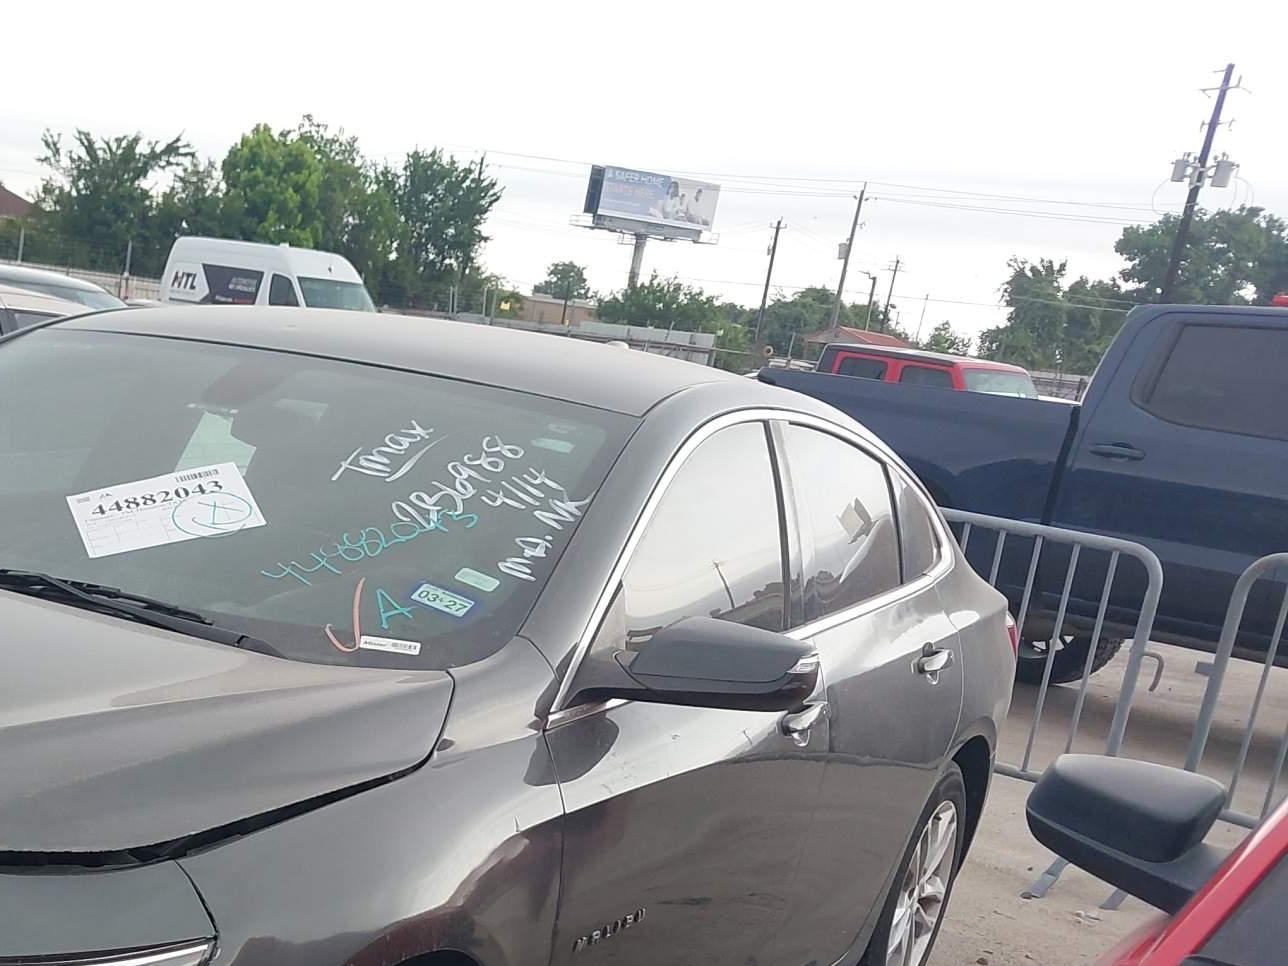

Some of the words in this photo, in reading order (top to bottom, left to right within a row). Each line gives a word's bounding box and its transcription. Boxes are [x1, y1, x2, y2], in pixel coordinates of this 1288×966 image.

[92, 480, 224, 516] 44882043
[417, 589, 439, 603] 03
[443, 599, 469, 613] 27
